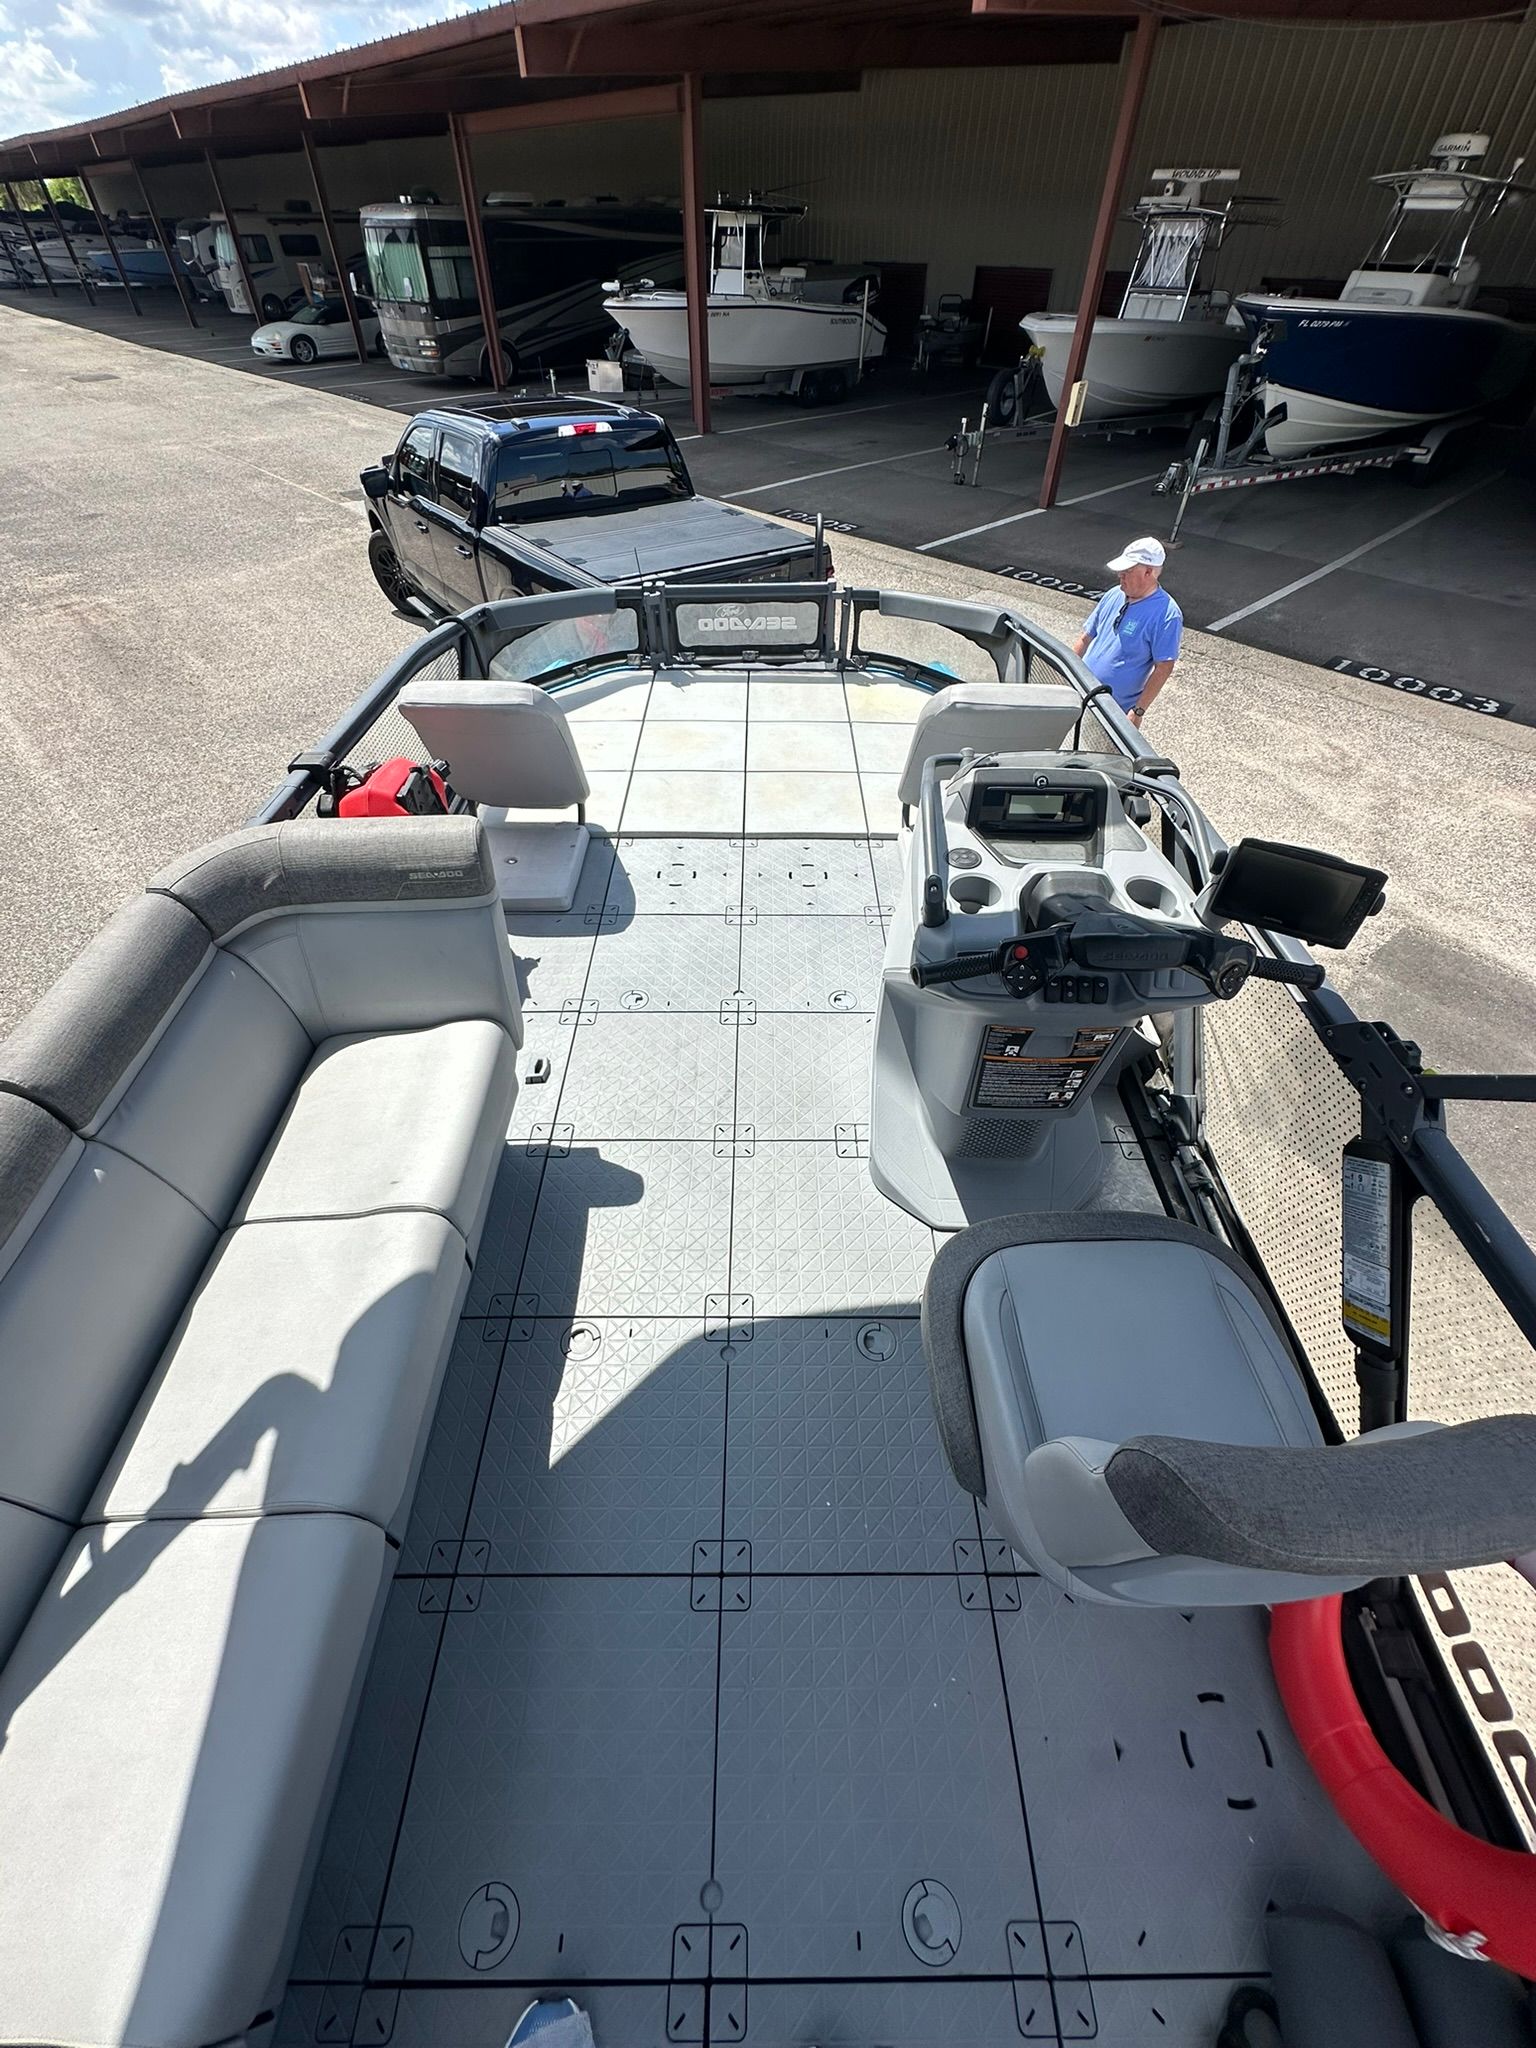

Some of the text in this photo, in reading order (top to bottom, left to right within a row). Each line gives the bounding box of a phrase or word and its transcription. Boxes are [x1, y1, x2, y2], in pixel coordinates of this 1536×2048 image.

[1437, 143, 1471, 152] GARMIN
[1207, 169, 1221, 179] UP
[1298, 319, 1310, 328] FL
[719, 605, 742, 618] Ford
[1334, 659, 1500, 713] 10003
